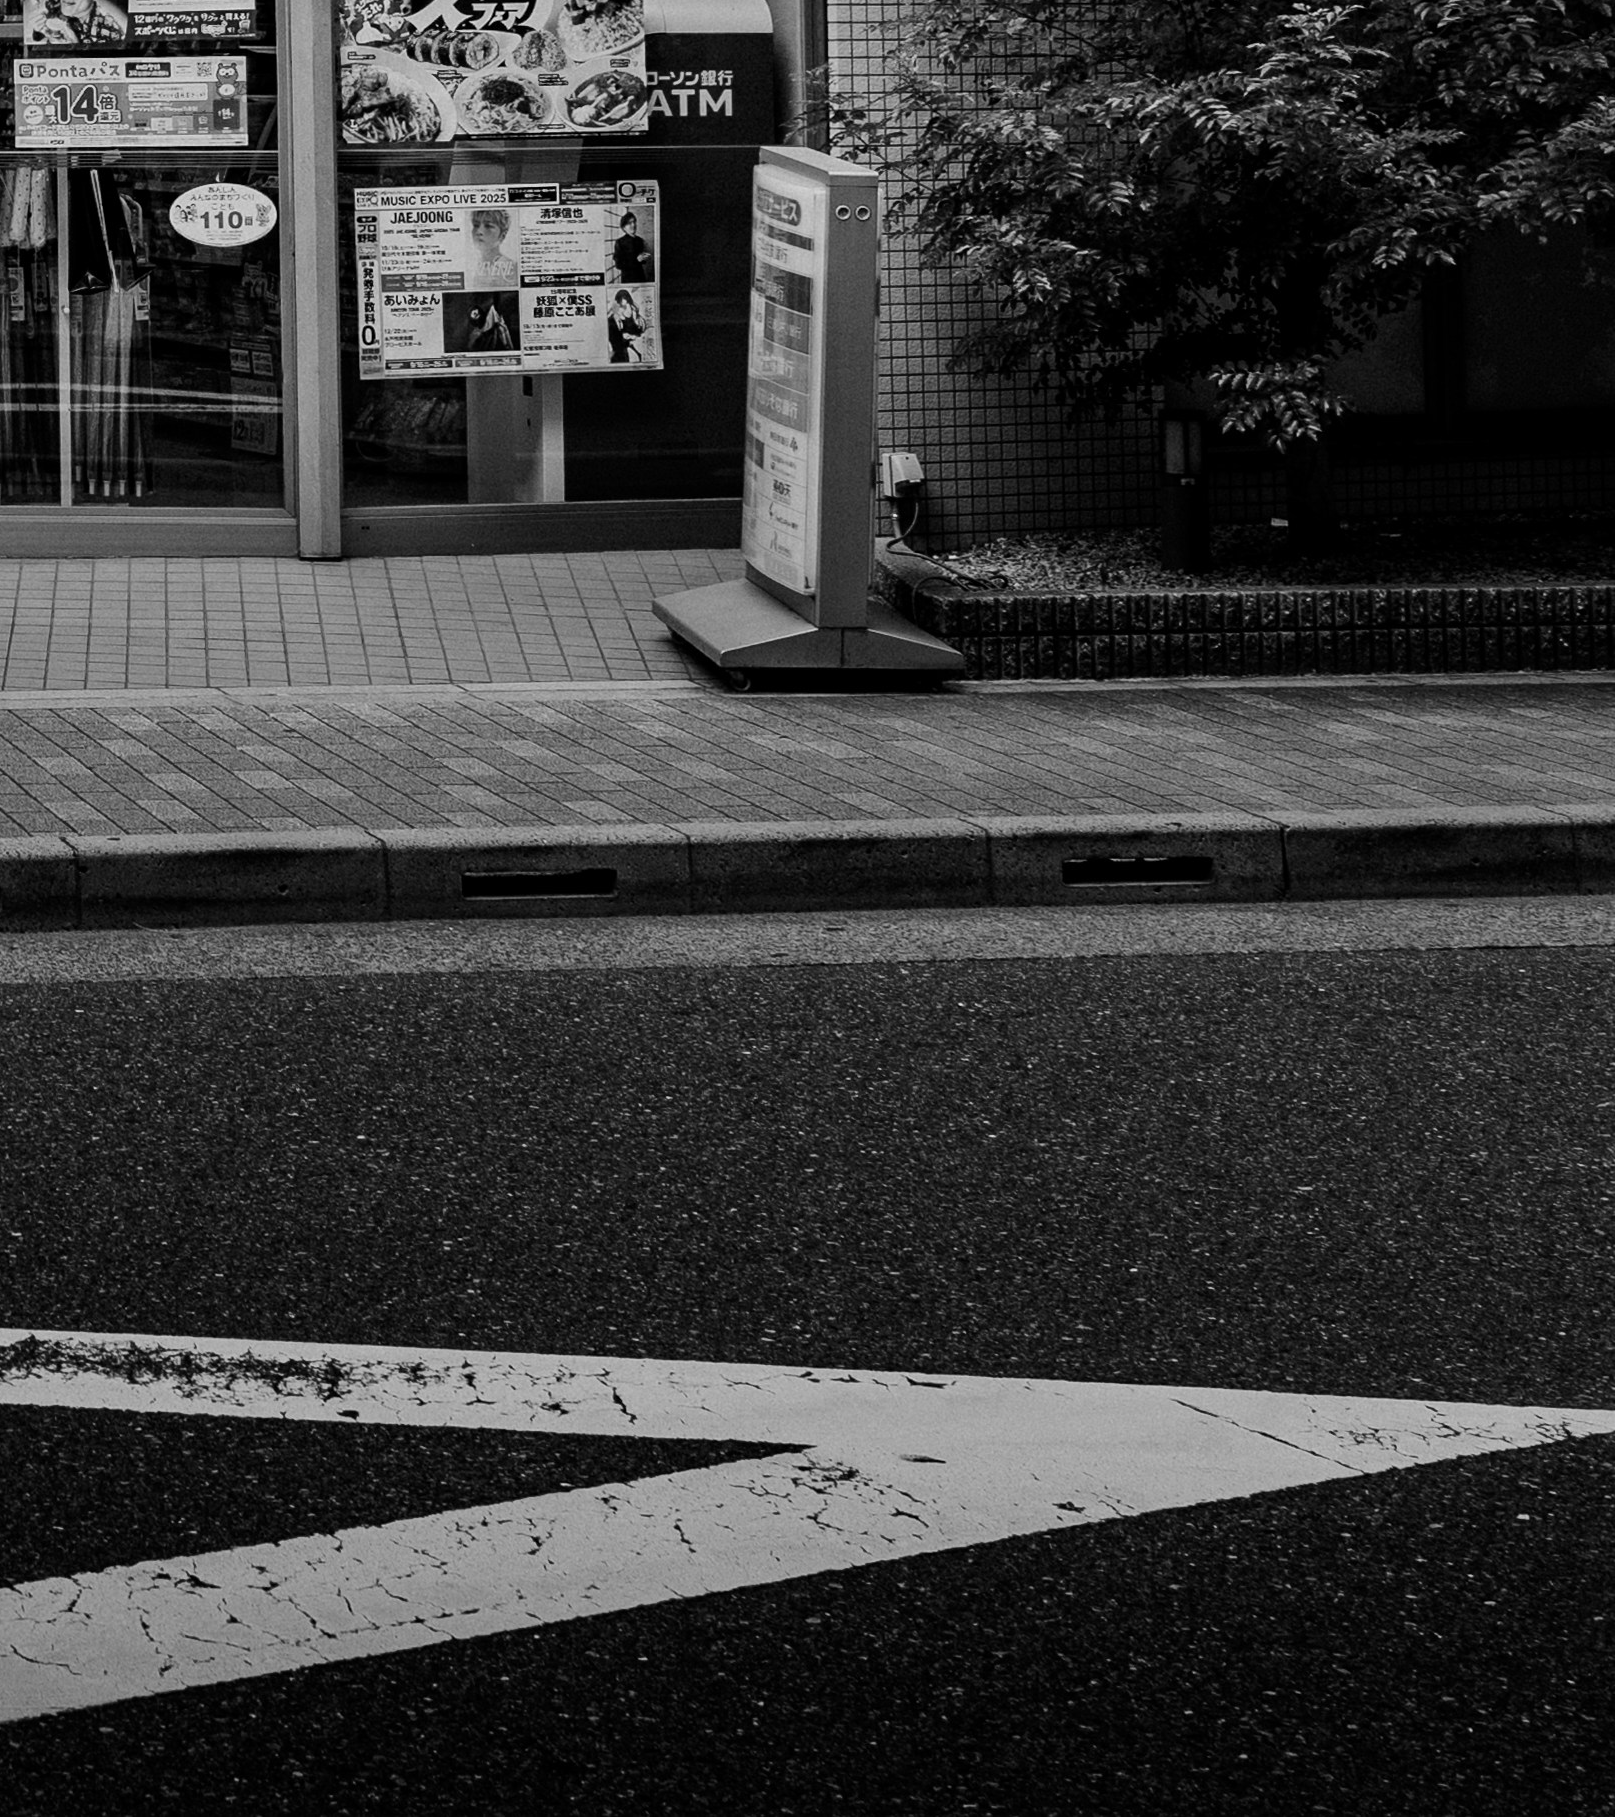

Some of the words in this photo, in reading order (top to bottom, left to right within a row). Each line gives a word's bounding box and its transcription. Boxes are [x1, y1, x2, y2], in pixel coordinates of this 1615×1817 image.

[647, 70, 734, 87] ローソン銀行
[52, 85, 99, 124] 14
[648, 89, 734, 117] ATM
[380, 195, 417, 207] MUSIC
[420, 194, 450, 205] EXPO
[453, 194, 477, 204] LIVE
[480, 193, 507, 203] 2025
[390, 211, 453, 224] JAEJOONG
[540, 208, 584, 219] 清塚信也
[357, 225, 377, 233] プロ
[357, 234, 377, 243] 野球
[362, 267, 376, 324] 発券手数料
[384, 294, 440, 306] あいみょん
[533, 307, 596, 318] 藤原ここあ展
